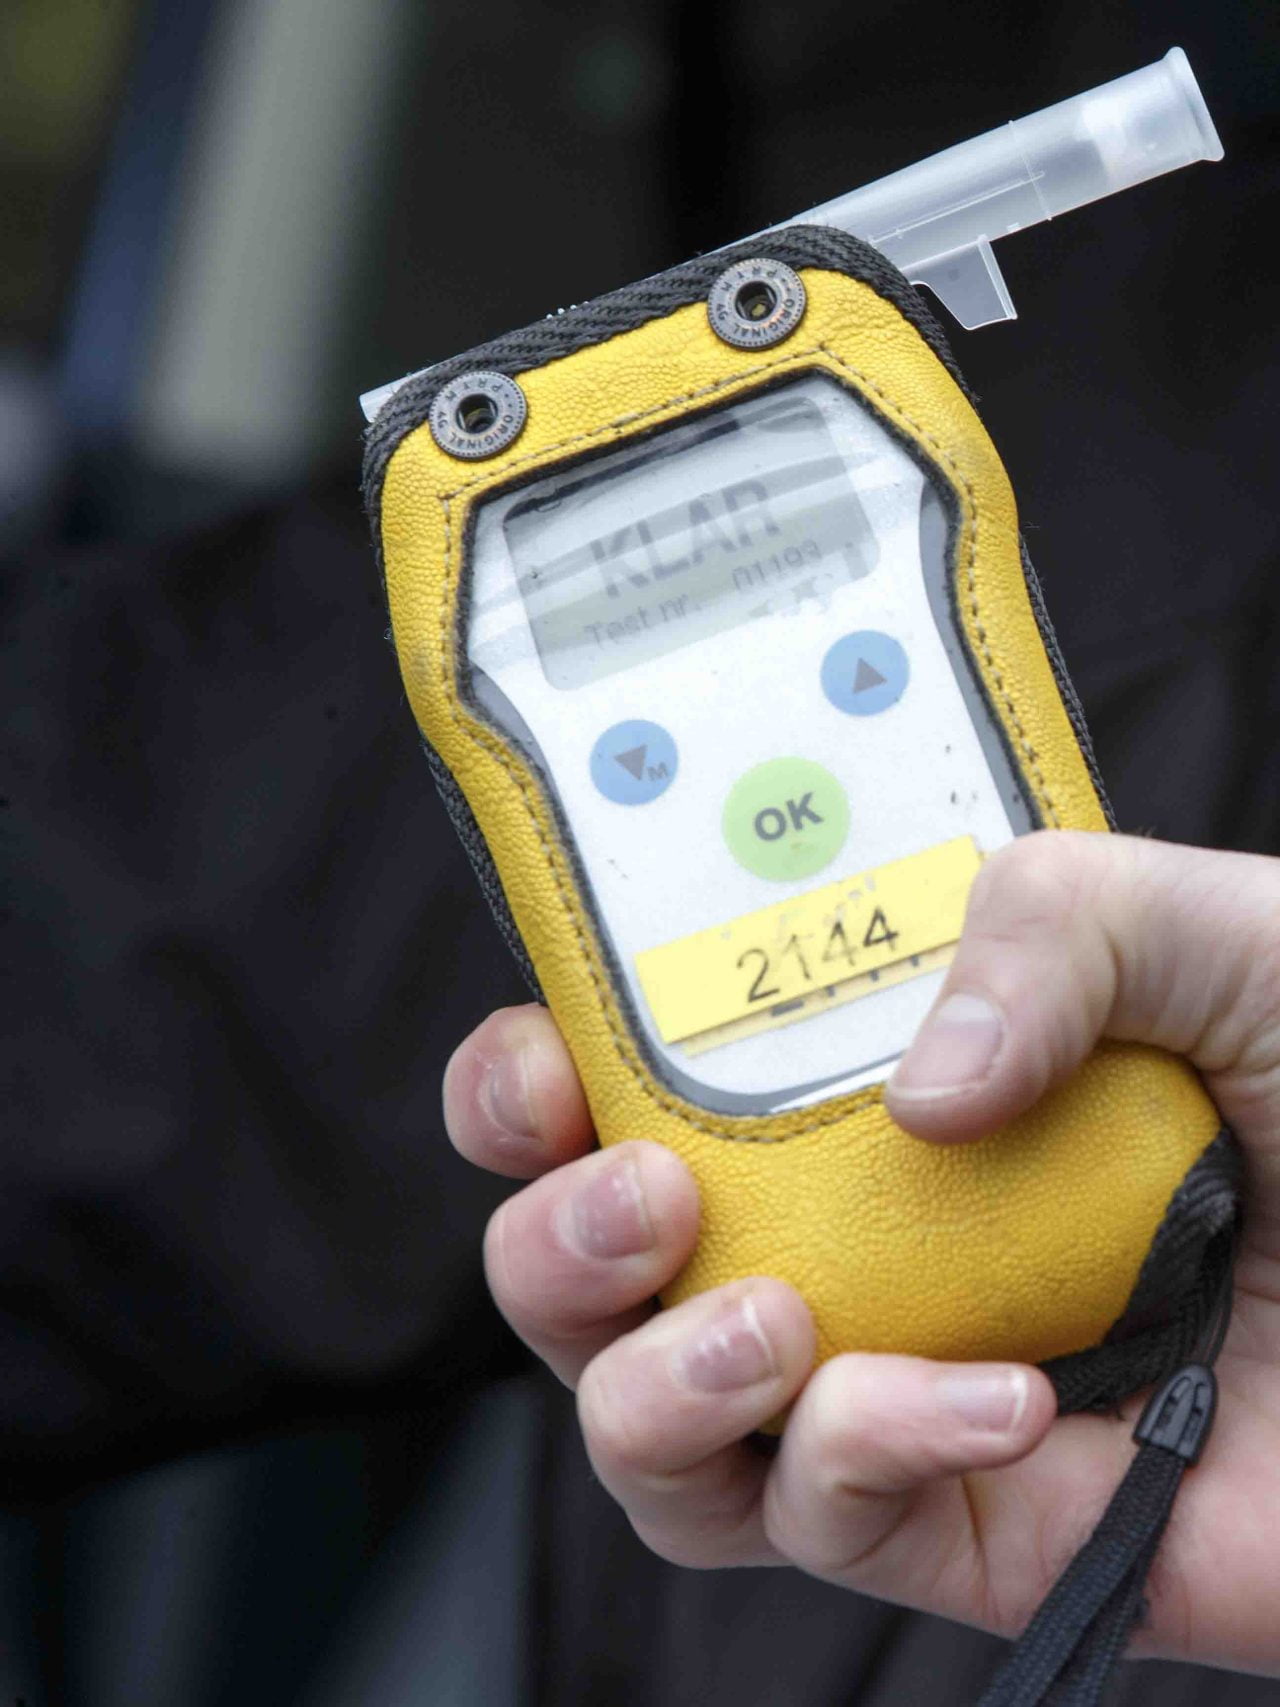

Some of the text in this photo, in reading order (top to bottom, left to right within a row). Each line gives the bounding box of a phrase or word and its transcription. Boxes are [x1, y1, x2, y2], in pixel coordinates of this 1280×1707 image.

[732, 298, 796, 338] ORIGINAL
[448, 414, 514, 450] ORIGINAL
[589, 479, 780, 599] KLAR
[582, 606, 651, 651] Test
[646, 762, 670, 783] M
[753, 791, 825, 842] OK
[735, 904, 900, 1004] 2144
